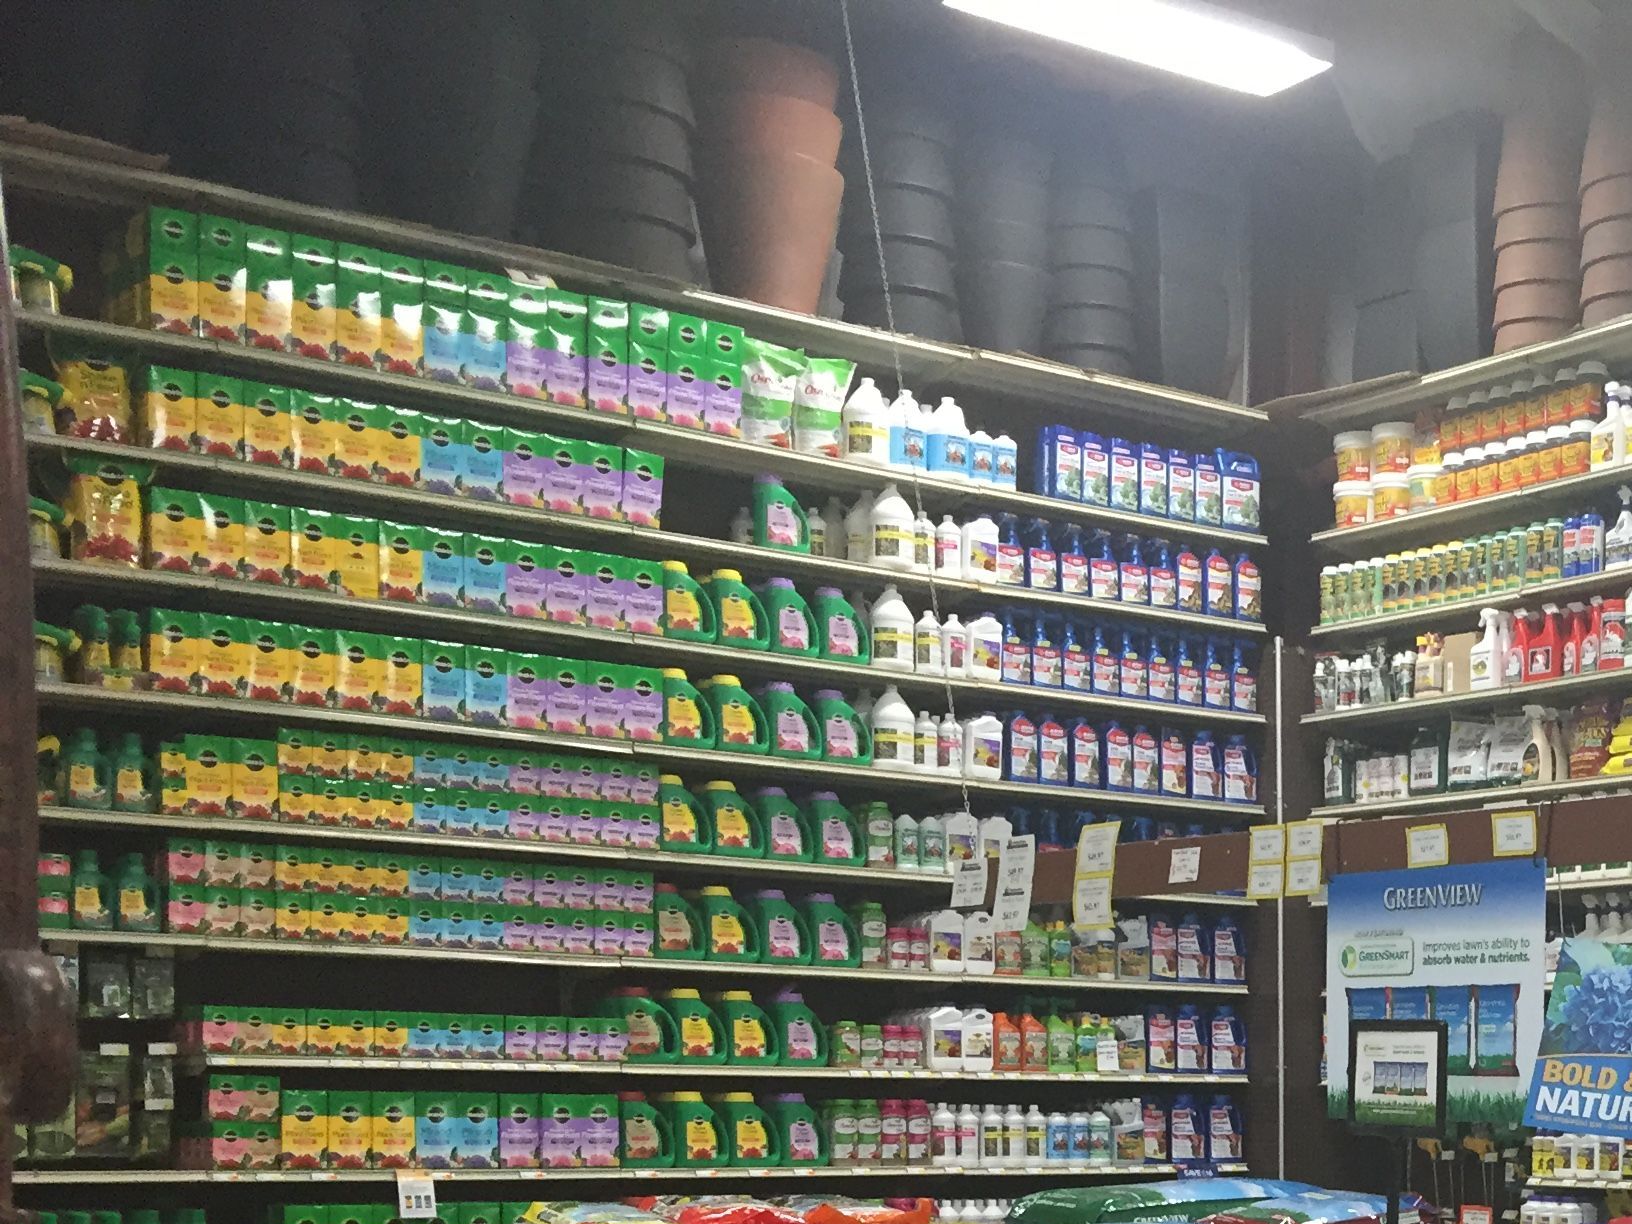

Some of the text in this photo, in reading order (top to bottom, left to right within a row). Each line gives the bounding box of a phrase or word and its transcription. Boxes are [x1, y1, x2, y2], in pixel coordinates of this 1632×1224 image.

[1383, 882, 1483, 912] GREENVIEW
[1422, 938, 1530, 953] Improves lawn's ability to
[1422, 952, 1530, 966] absorb water & nutrients.
[1542, 1059, 1615, 1091] BOLD
